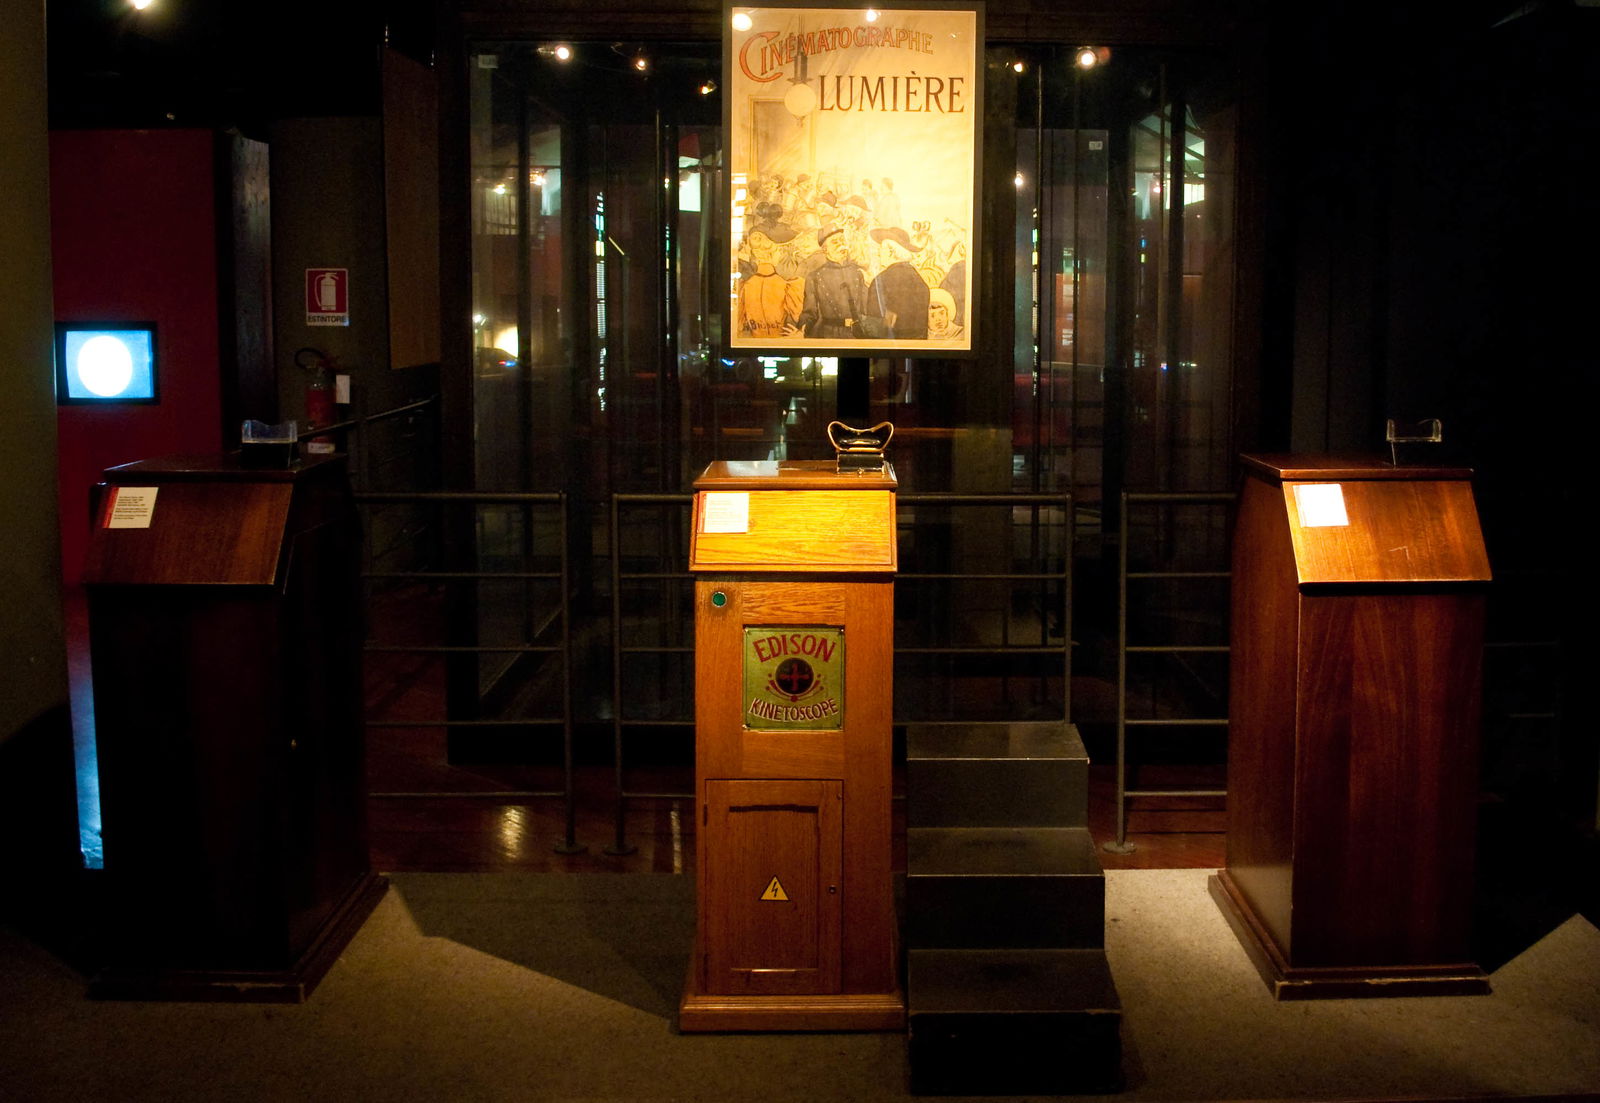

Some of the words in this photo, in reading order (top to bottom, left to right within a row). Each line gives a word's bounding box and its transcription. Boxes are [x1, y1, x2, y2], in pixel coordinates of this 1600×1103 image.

[739, 26, 935, 82] CINÉMATOGRAPHE
[819, 71, 965, 113] LUMIÈRE
[308, 315, 347, 323] ESTINTORE
[752, 634, 836, 663] EDISON
[748, 697, 839, 722] KINETOSCOPE
